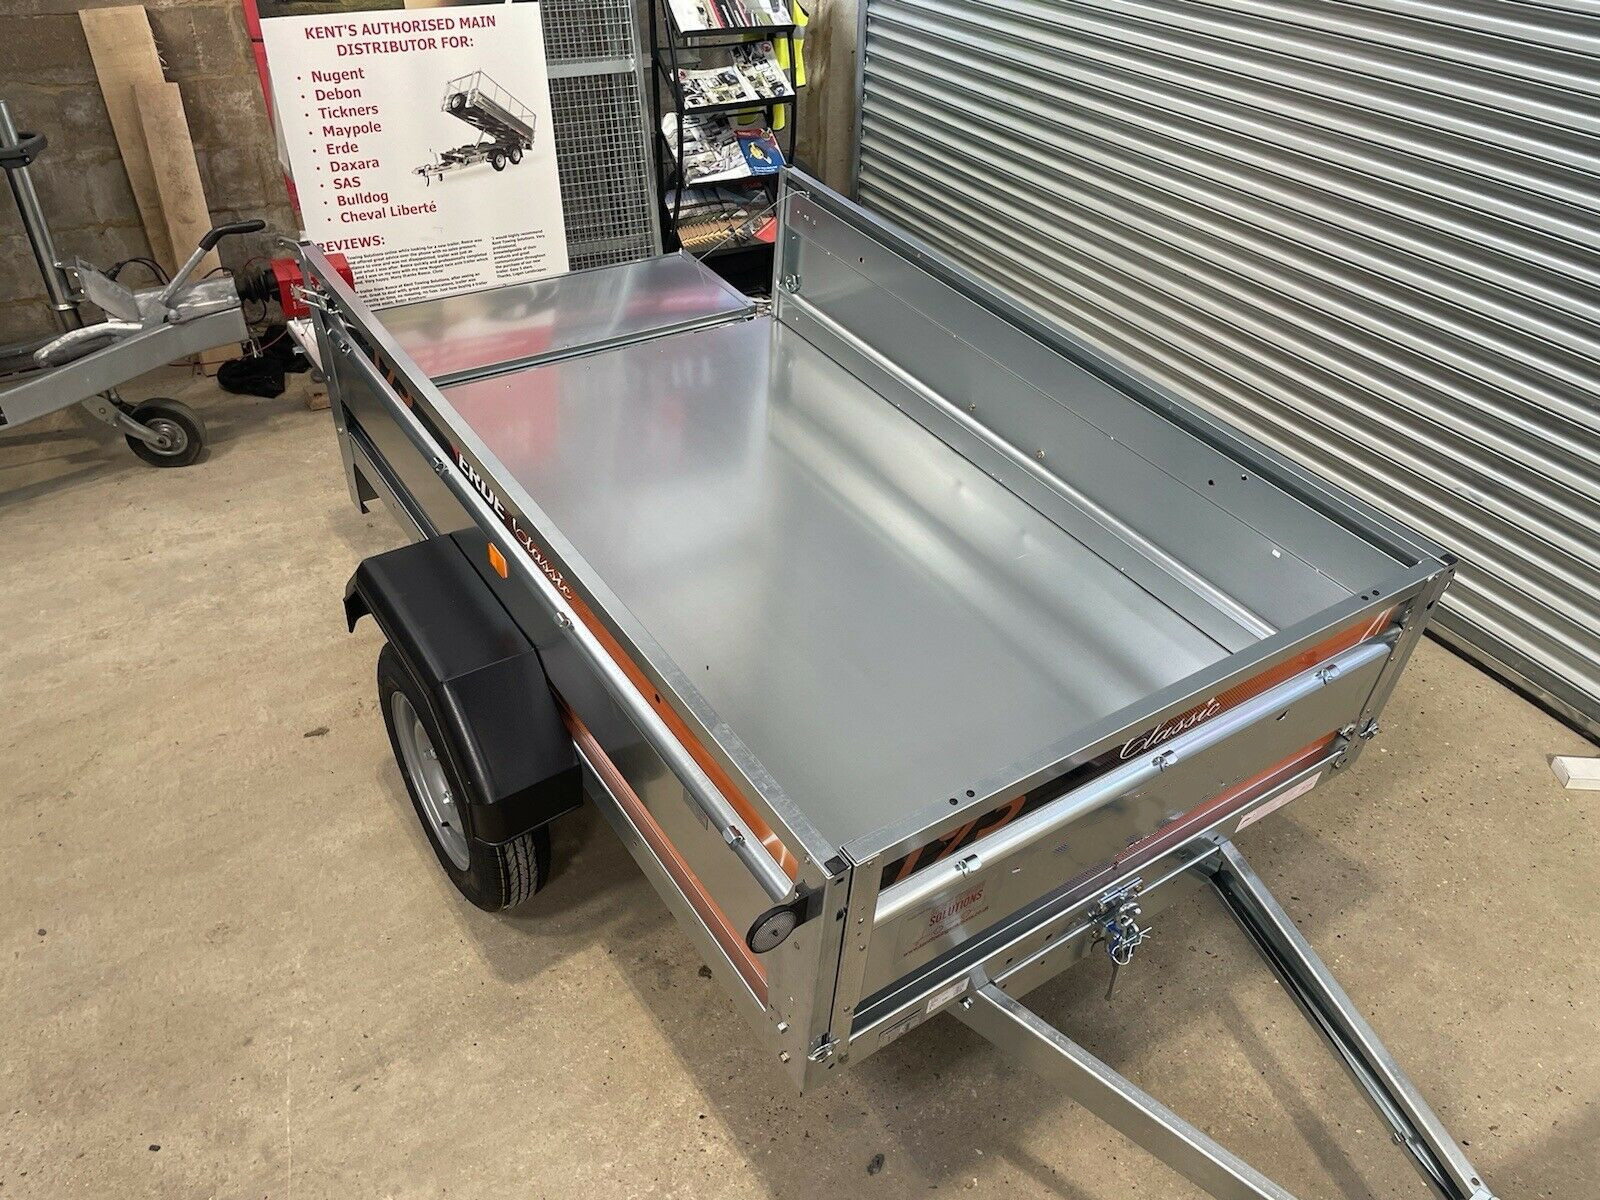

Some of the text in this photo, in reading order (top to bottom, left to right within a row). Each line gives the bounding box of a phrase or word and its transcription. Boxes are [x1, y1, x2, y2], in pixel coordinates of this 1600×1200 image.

[304, 15, 497, 40] KENT'S AUTHORISED MAIN
[336, 35, 474, 57] DISTRIBUTOR FOR:
[311, 67, 366, 84] Nugent
[315, 87, 362, 101] Debon
[318, 104, 379, 119] Tickners
[322, 121, 382, 138] Maypole
[326, 141, 359, 155] Erde
[330, 158, 380, 172] Daxara
[333, 176, 361, 190] SAS
[337, 192, 389, 207] Bulldog
[340, 200, 438, 223] Cheval Liberté
[316, 234, 385, 254] REVIEWS:
[1119, 697, 1222, 760] Classic
[928, 888, 984, 928] SOLUTIONS
